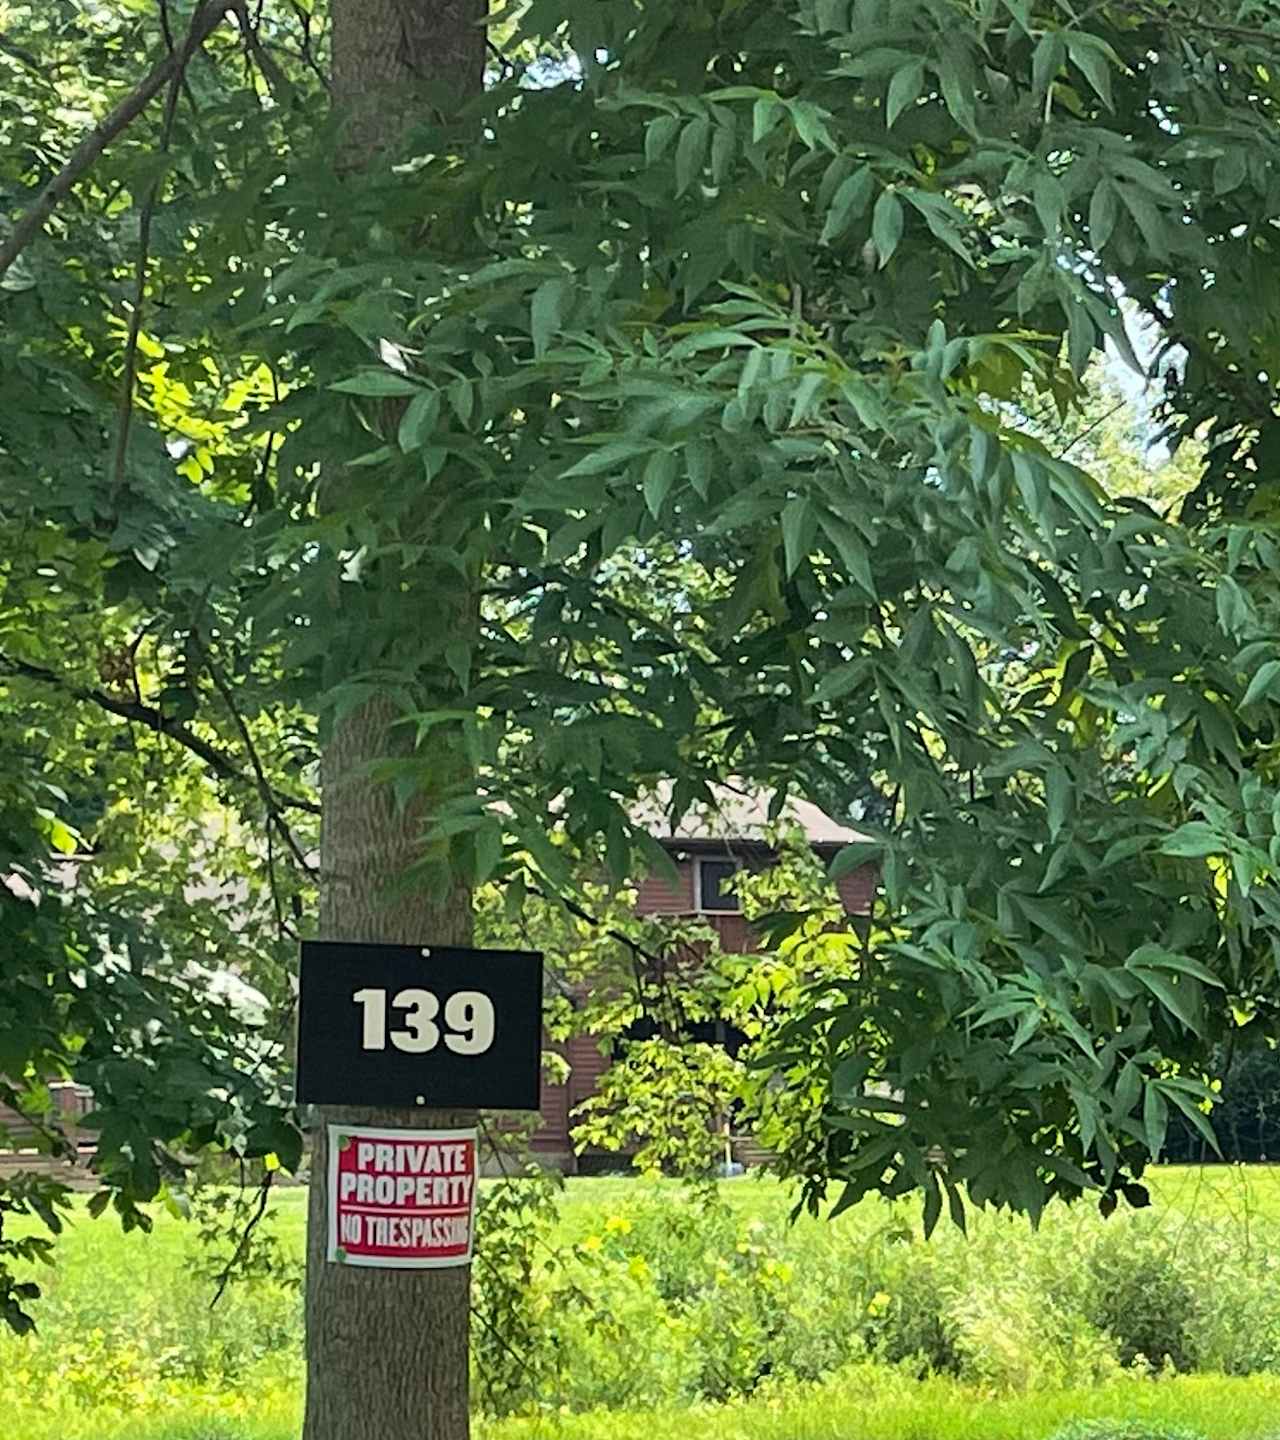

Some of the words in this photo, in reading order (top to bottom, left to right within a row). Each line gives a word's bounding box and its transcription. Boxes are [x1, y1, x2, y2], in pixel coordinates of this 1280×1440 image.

[353, 988, 495, 1055] 139
[357, 1142, 467, 1173] PRIVATE
[340, 1172, 473, 1206] PROPERTY
[340, 1213, 362, 1245] NO
